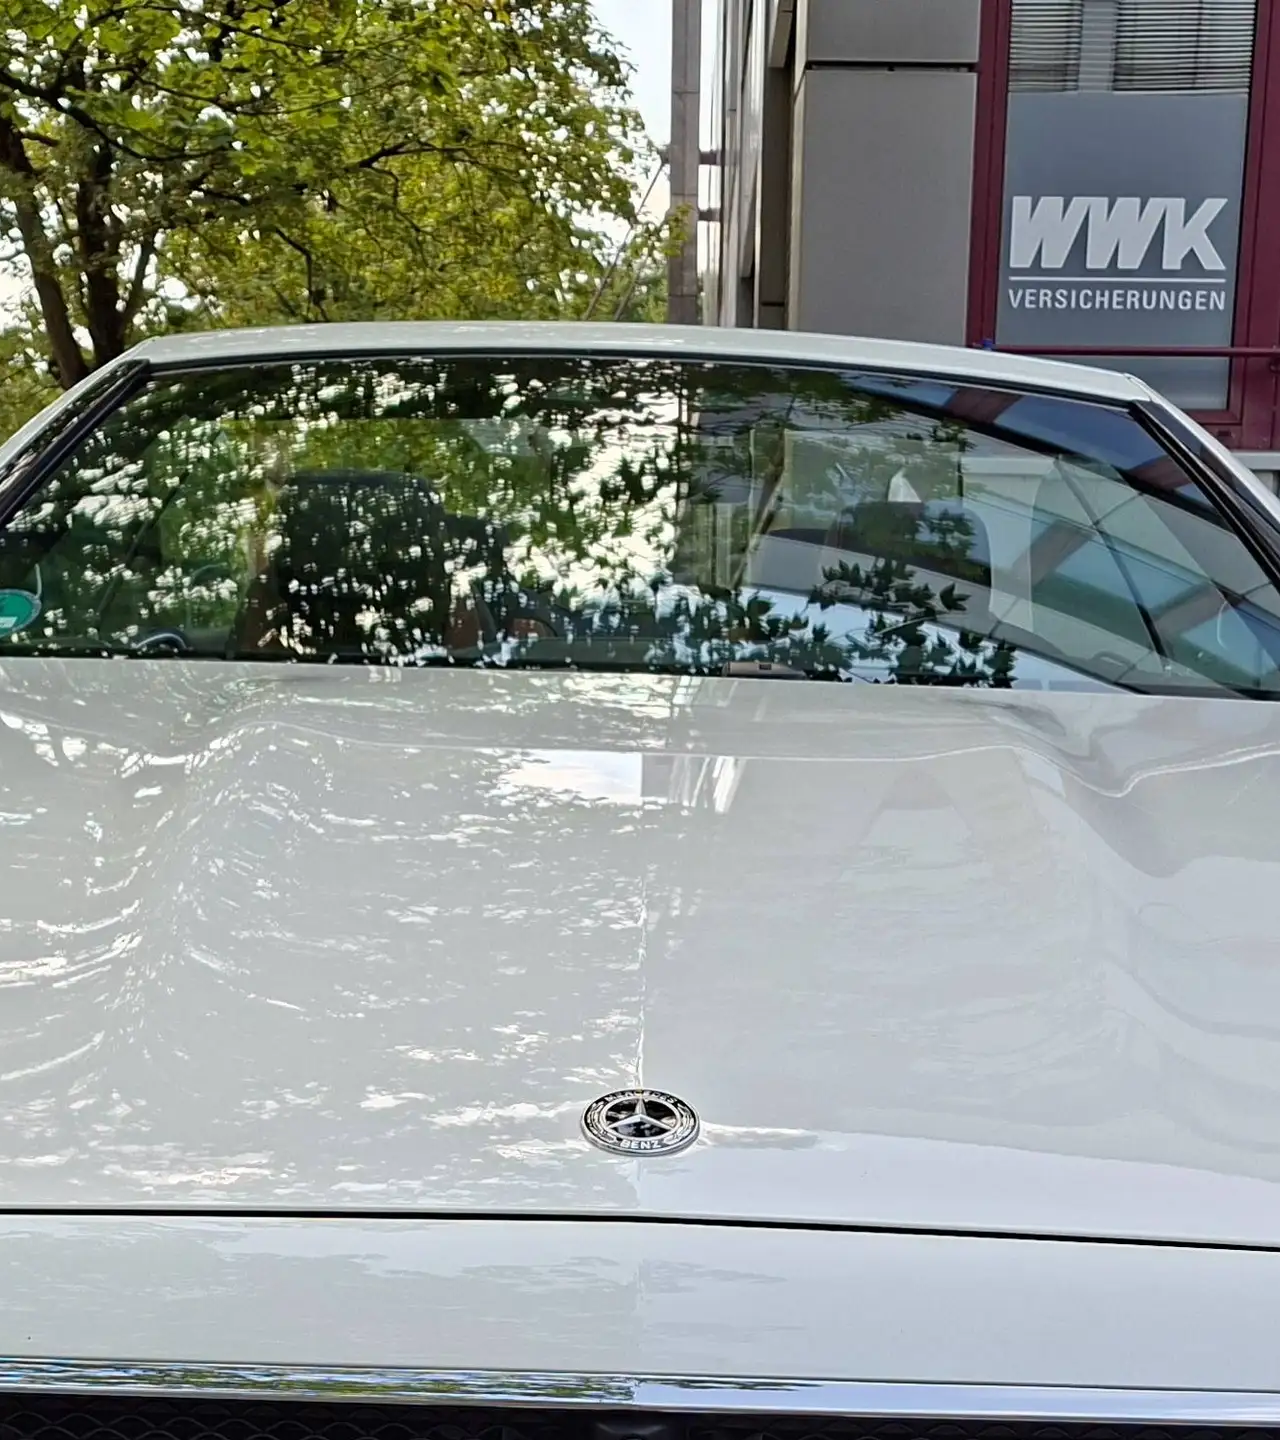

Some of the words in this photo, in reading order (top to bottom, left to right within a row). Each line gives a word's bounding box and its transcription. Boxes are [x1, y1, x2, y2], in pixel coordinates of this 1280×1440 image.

[1009, 195, 1229, 271] WWK
[1008, 288, 1226, 311] VERSICHERUNGEN
[619, 1139, 662, 1150] BENZ
